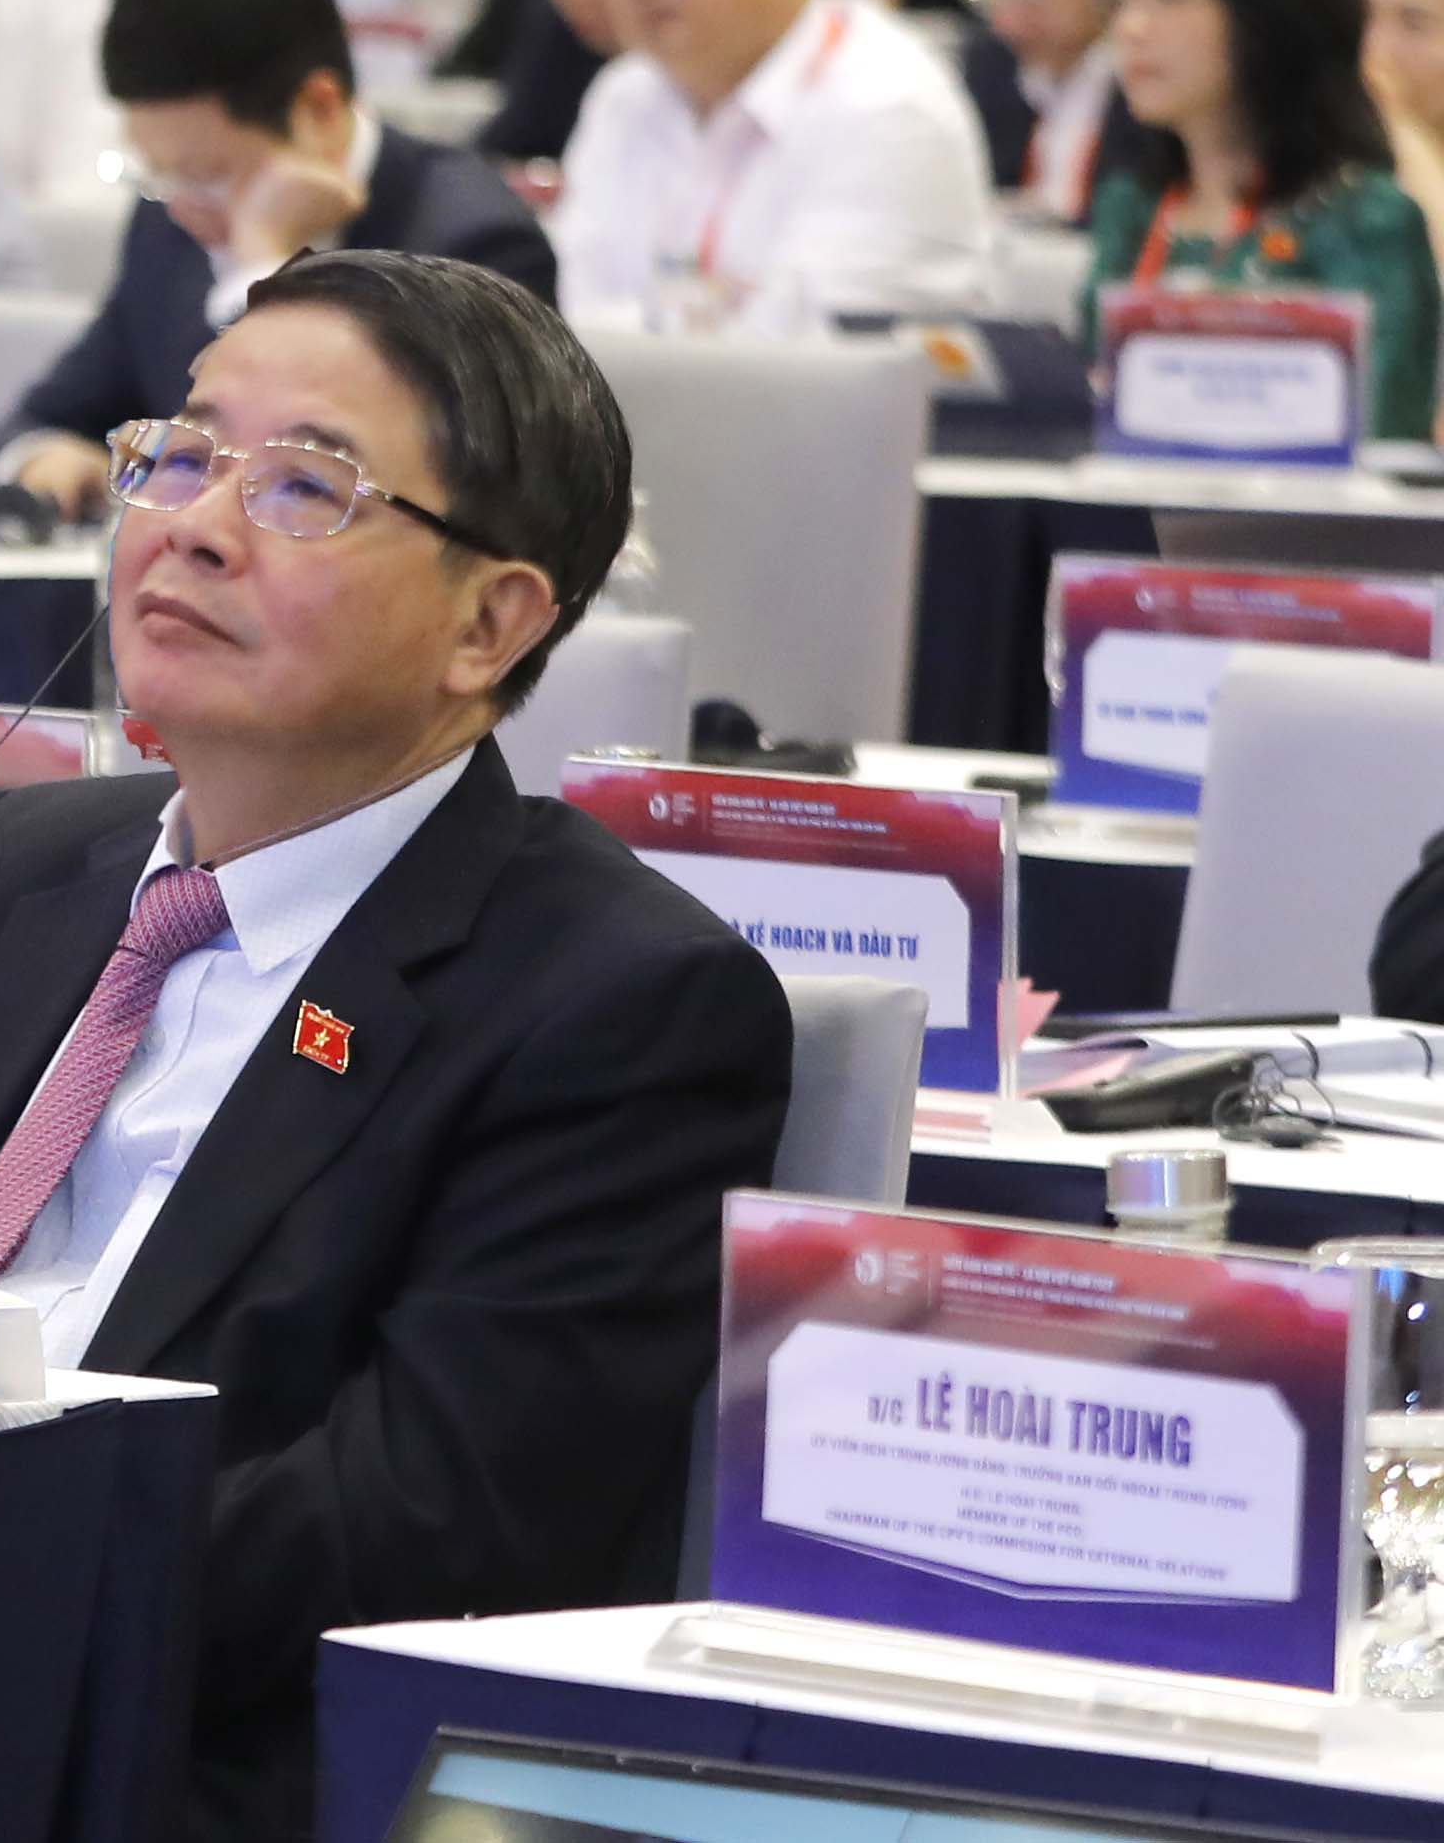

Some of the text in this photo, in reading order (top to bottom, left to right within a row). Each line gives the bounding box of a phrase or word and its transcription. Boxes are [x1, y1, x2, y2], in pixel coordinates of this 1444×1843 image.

[771, 924, 826, 953] HOẠCH
[833, 927, 852, 953] VÀ
[898, 934, 918, 960] TƯ
[917, 1372, 953, 1434] LÊ
[966, 1385, 1052, 1449] HOÀI
[1067, 1400, 1192, 1468] TRUNG
